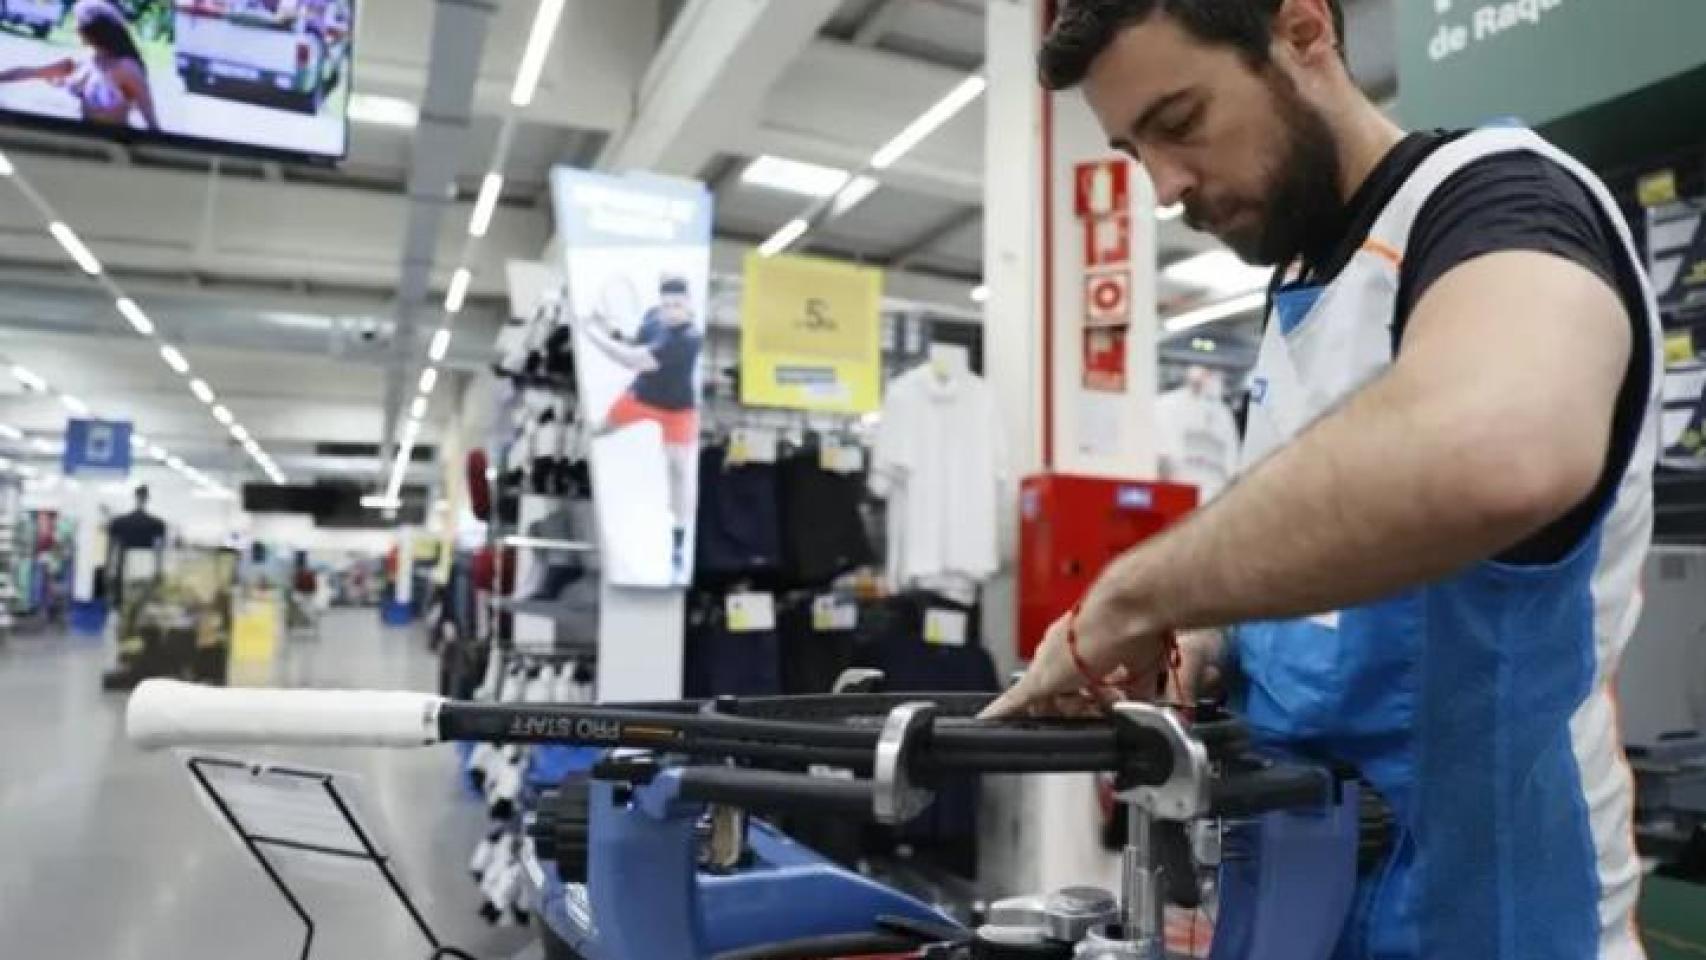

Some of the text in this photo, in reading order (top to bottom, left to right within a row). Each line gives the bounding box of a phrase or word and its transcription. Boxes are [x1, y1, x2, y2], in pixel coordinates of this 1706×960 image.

[1429, 25, 1467, 60] de
[510, 712, 621, 740] PRO STAFF
